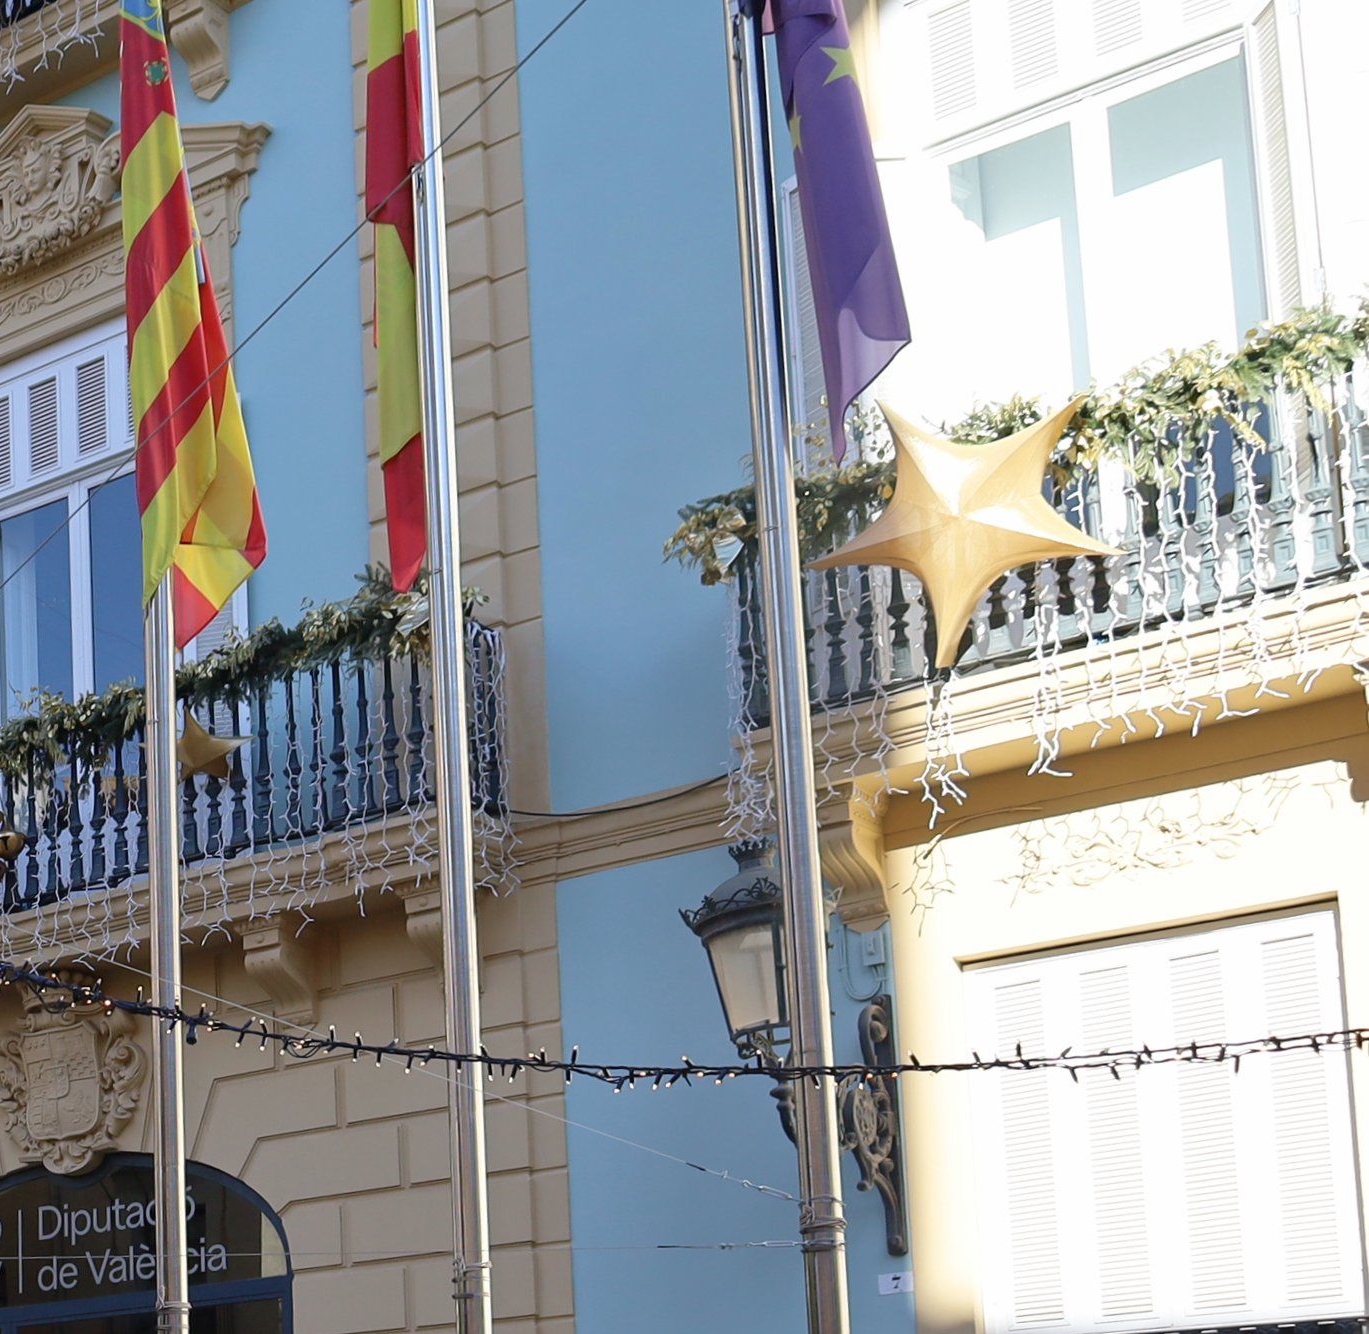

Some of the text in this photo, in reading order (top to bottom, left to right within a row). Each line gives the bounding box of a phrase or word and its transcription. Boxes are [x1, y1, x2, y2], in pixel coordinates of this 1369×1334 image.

[37, 1185, 196, 1246] Diputacó
[37, 1236, 228, 1292] de Valècia
